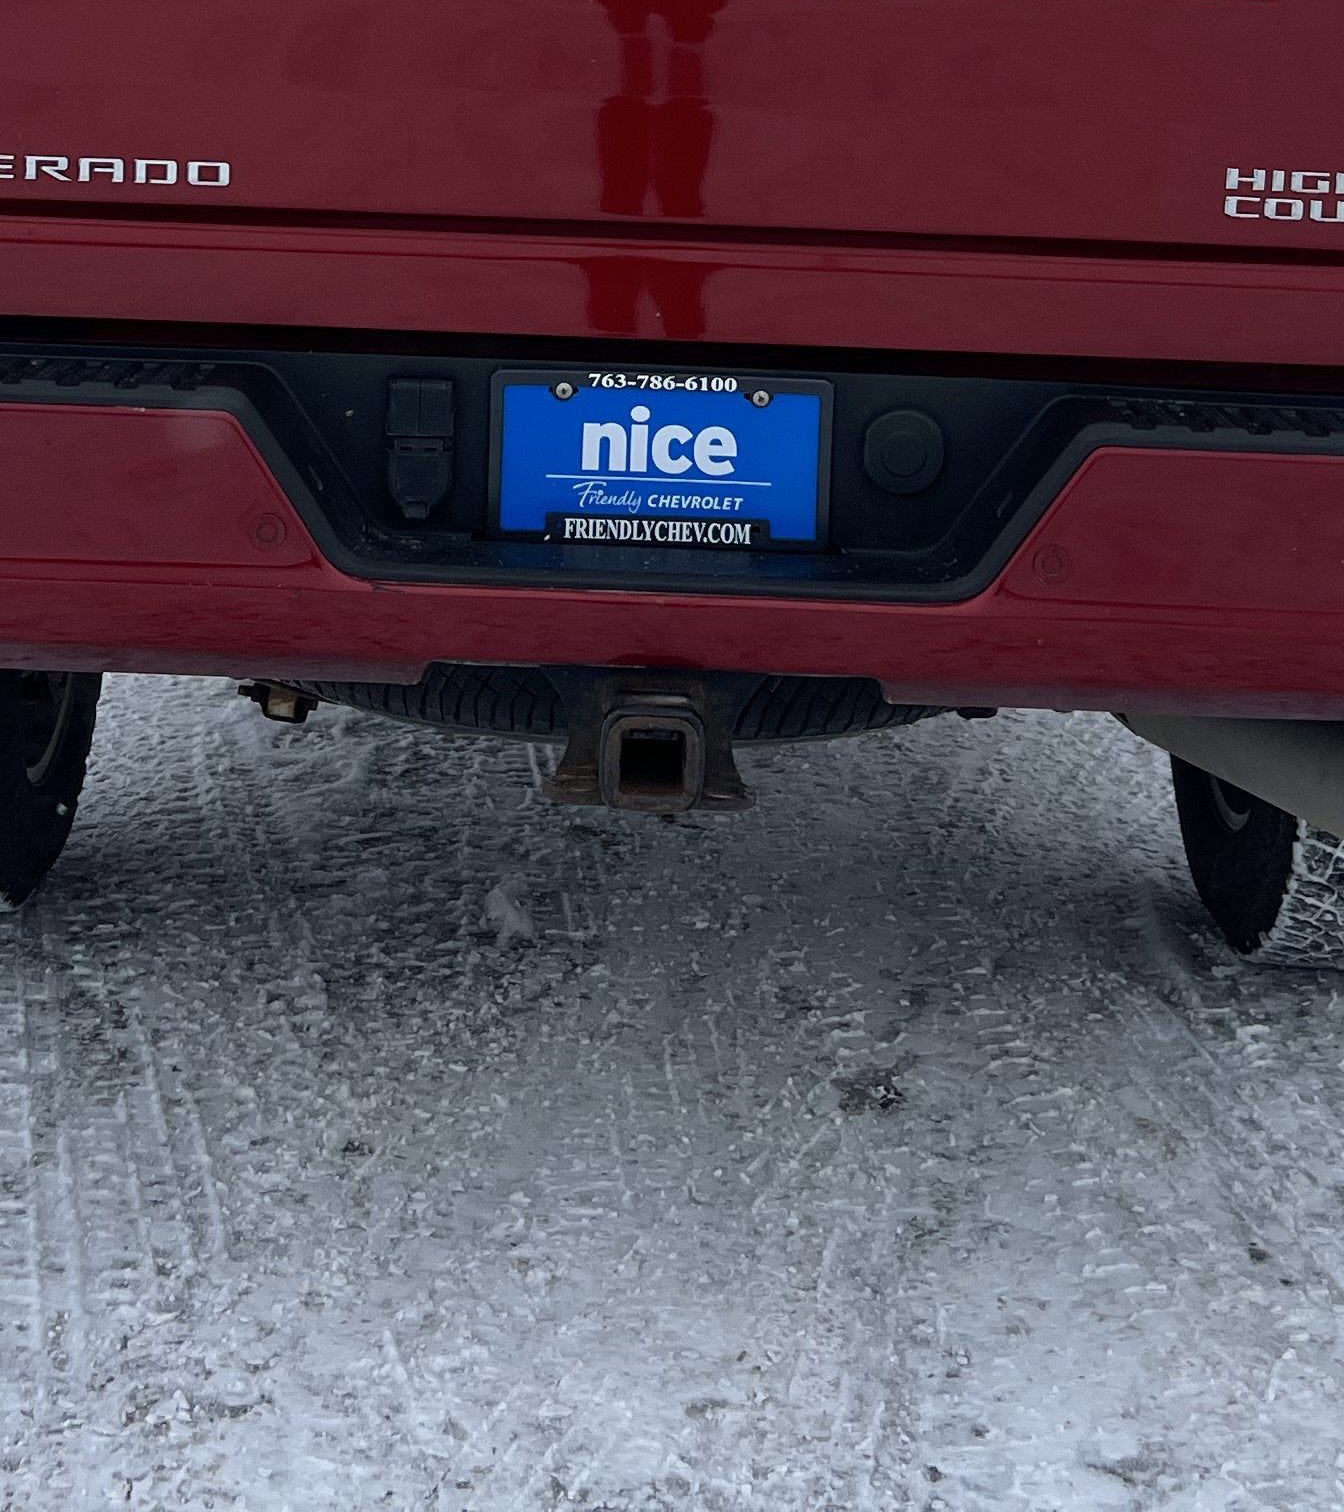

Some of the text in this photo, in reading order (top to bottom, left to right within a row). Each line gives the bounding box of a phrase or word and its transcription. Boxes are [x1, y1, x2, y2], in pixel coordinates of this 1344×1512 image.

[588, 372, 738, 393] 763-786-6100
[581, 405, 738, 476] nice
[573, 481, 744, 514] Friendly CHEVROLET
[564, 518, 752, 545] FRIENDLYCHEV.COM
